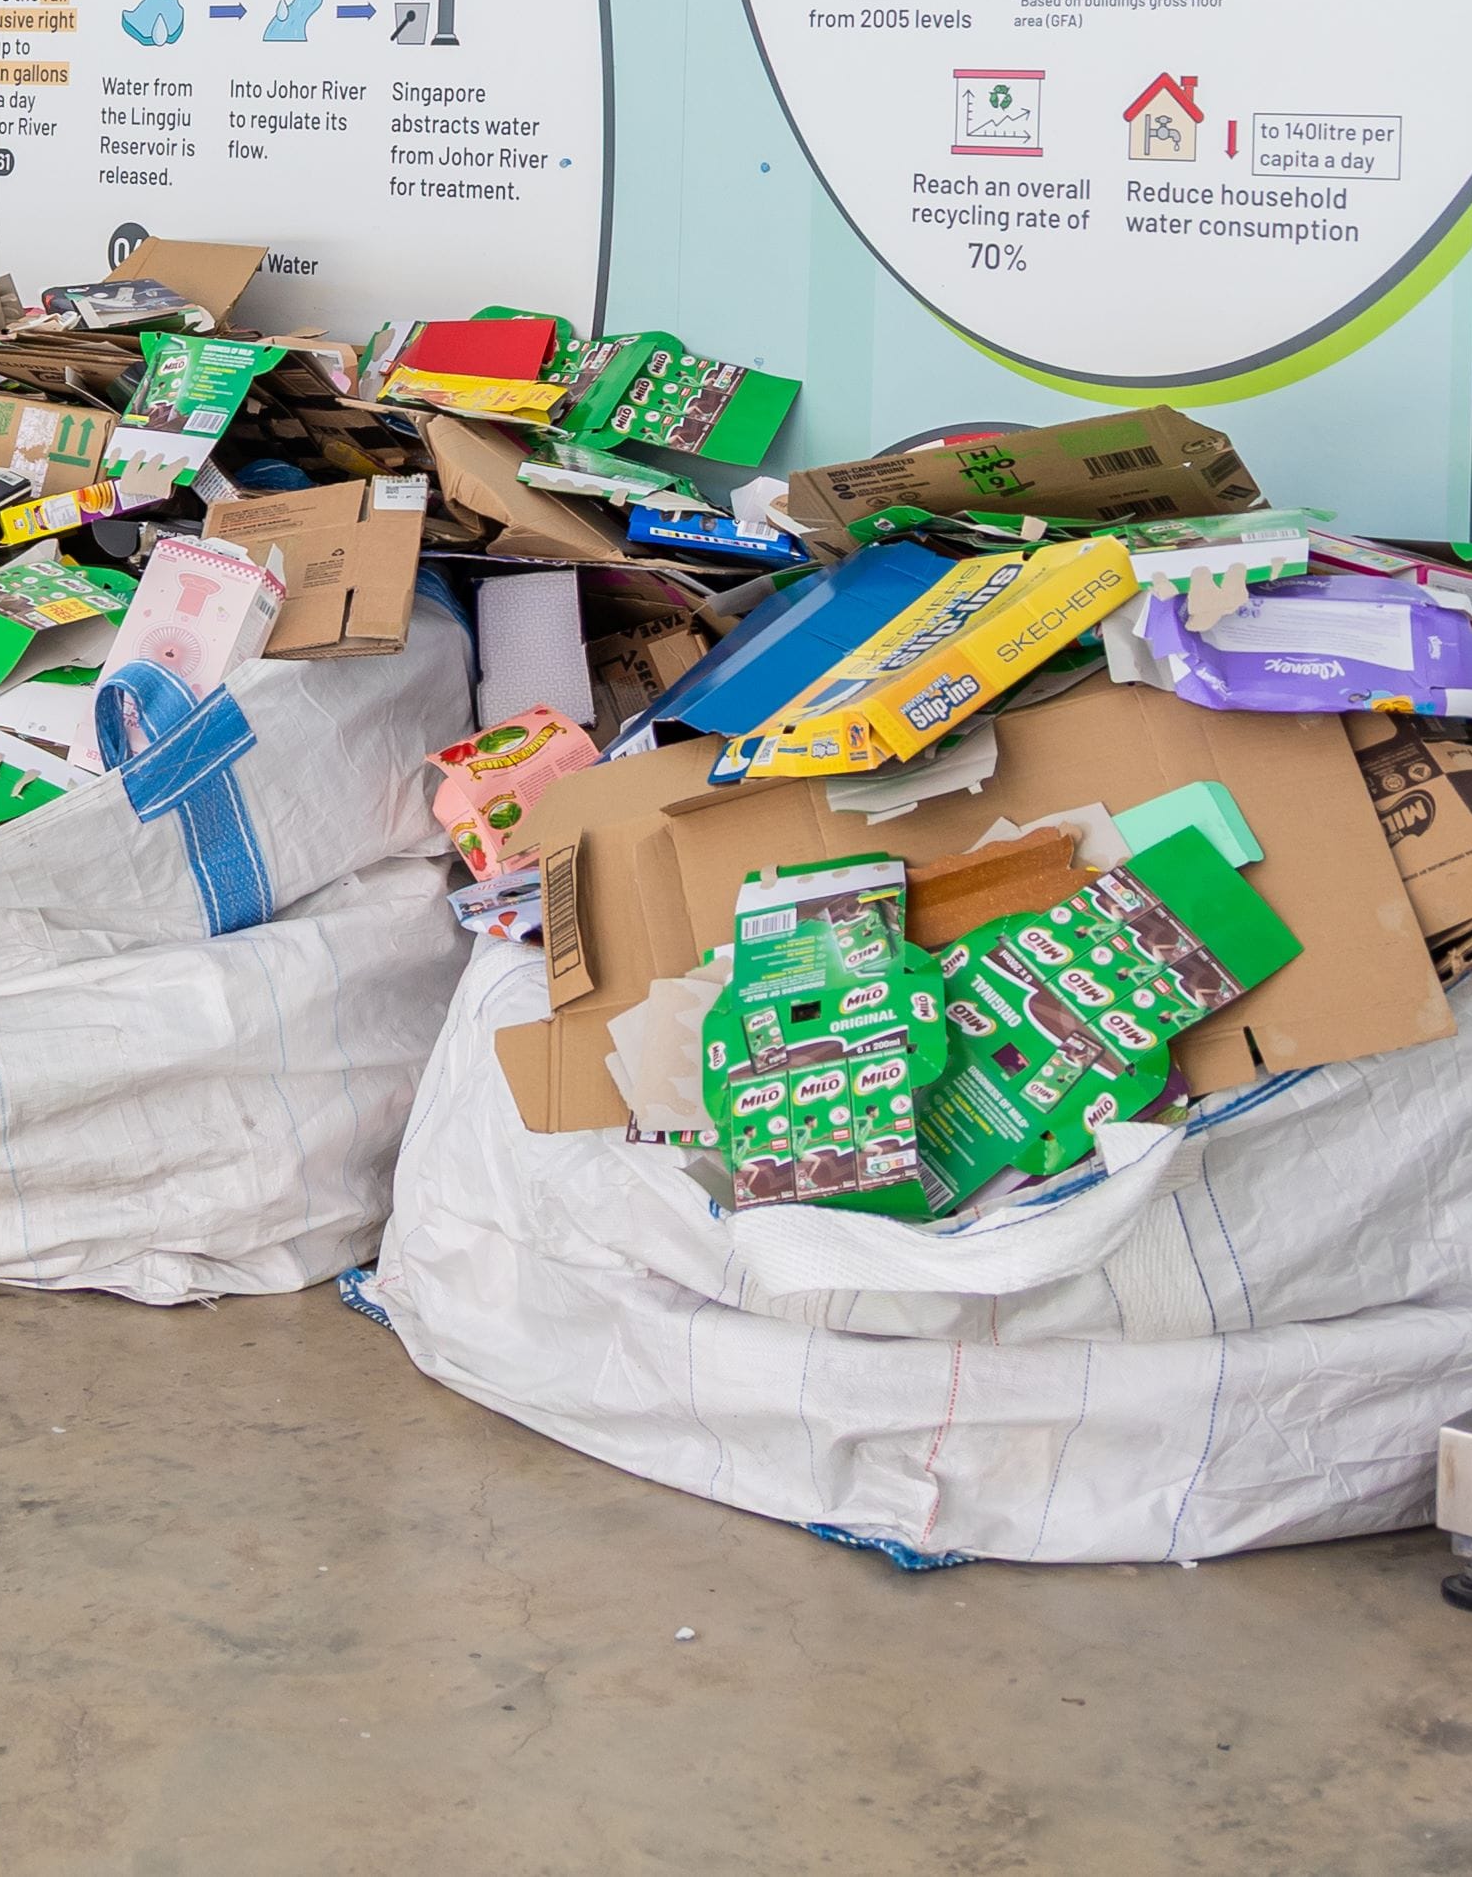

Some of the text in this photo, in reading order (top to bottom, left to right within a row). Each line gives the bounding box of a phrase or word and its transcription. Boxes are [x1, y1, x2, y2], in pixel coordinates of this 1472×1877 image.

[231, 80, 366, 100] Into Johor River
[969, 243, 1026, 271] 70%
[827, 459, 915, 480] NON-CARBONATED
[830, 465, 907, 485] ISOTONIC DRINK
[961, 459, 1016, 479] TWO
[997, 570, 1121, 662] SKECHERS
[1263, 653, 1347, 680] Kleenex
[1026, 928, 1066, 958] MILO
[847, 988, 883, 1007] MILO
[1068, 973, 1108, 1003] MILO
[830, 1010, 897, 1033] ORIGINAL
[1109, 1013, 1149, 1044] MILO
[862, 1067, 900, 1087] MILO
[801, 1079, 840, 1098] MILO
[741, 1090, 779, 1109] MILO
